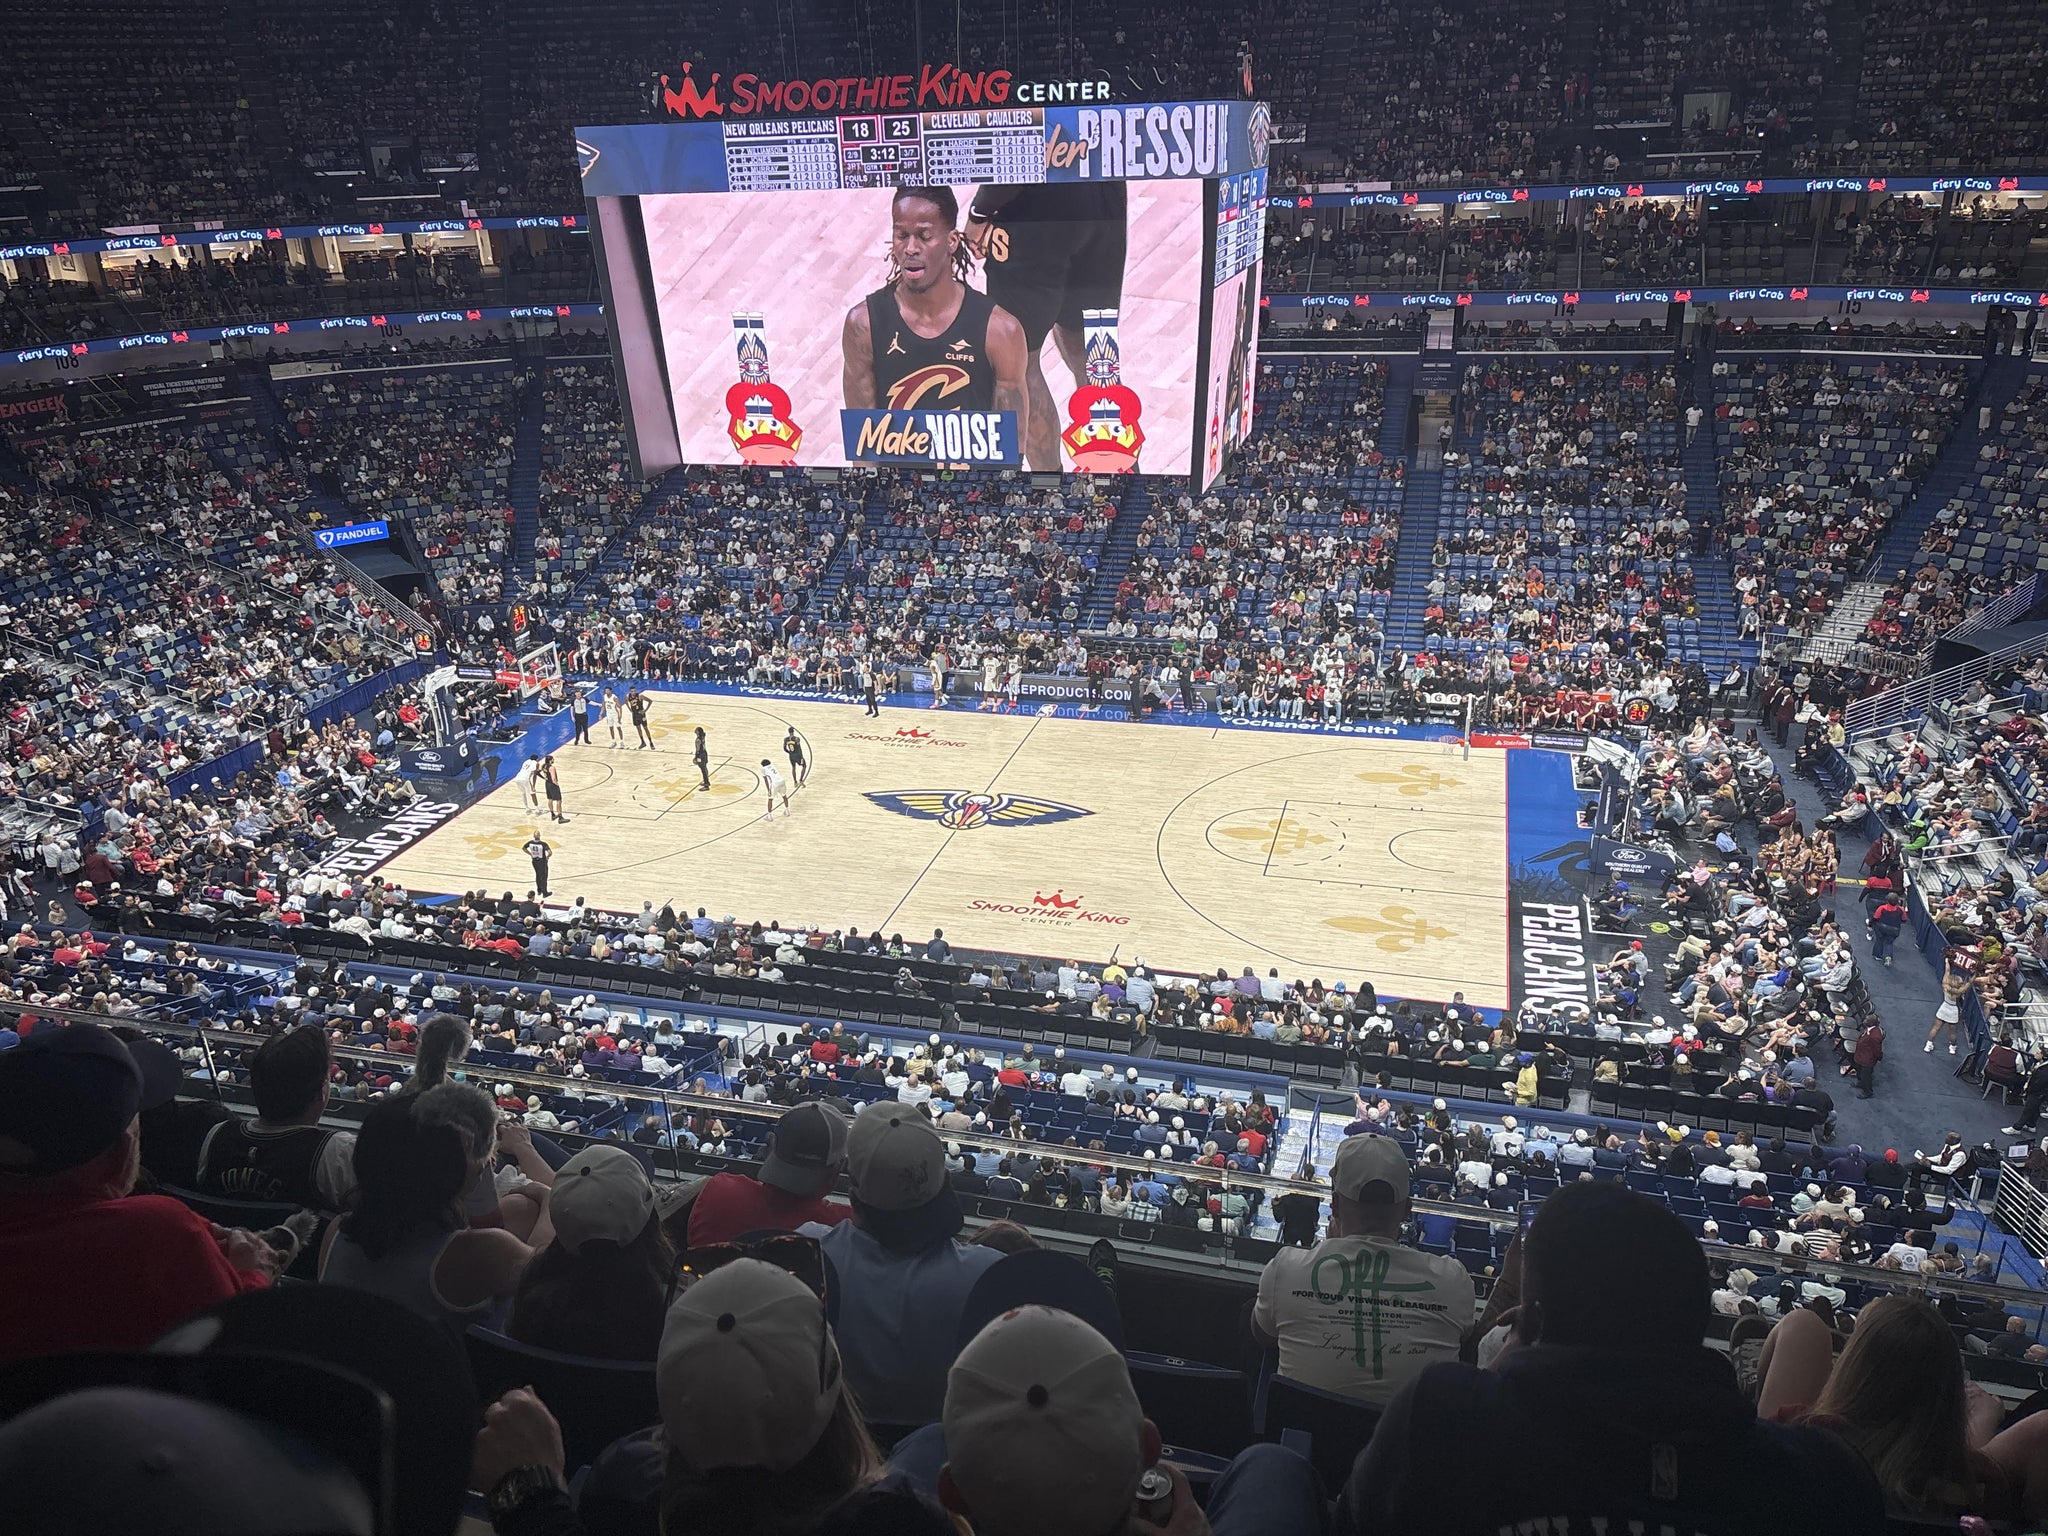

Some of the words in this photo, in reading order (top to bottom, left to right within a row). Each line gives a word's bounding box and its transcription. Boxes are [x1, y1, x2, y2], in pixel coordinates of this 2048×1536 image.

[729, 73, 913, 114] SMOOTHIE
[1017, 82, 1110, 102] CENTER
[931, 112, 981, 129] CLEVELAND
[986, 110, 1033, 127] CAVALIERS
[725, 123, 746, 136] NEW
[749, 121, 789, 135] ORLEANS
[791, 119, 835, 134] PELICANS
[852, 122, 869, 138] 18
[892, 121, 910, 136] 25
[870, 147, 895, 160] 3:12
[845, 174, 868, 182] FOULS
[1932, 178, 1961, 191] Fiery
[1964, 178, 1992, 191] Crab
[1686, 182, 1712, 194] Fiery
[1715, 182, 1740, 193] Crab
[1806, 179, 1833, 191] Fiery
[1836, 179, 1862, 191] Crab
[1458, 191, 1482, 204] Fiery
[1484, 190, 1507, 201] Crab
[1570, 186, 1594, 198] Fiery
[1598, 186, 1621, 197] Crab
[1271, 198, 1293, 208] Crab
[1350, 193, 1374, 207] Fiery
[1376, 195, 1398, 206] Crab
[419, 220, 441, 232] Fiery
[443, 219, 464, 230] Crab
[516, 217, 537, 228] Fiery
[539, 216, 559, 227] Crab
[215, 231, 239, 243] Fiery
[241, 230, 262, 240] Crab
[318, 226, 340, 236] Fiery
[342, 224, 365, 235] Crab
[106, 238, 131, 251] Fiery
[133, 236, 157, 247] Crab
[26, 245, 50, 256] Crab
[1302, 295, 1325, 306] Fiery
[1328, 295, 1350, 306] Crab
[1402, 295, 1426, 306] Fiery
[1428, 294, 1451, 305] Crab
[1507, 294, 1531, 306] Fiery
[1533, 293, 1557, 304] Crab
[1615, 291, 1641, 303] Fiery
[1644, 291, 1668, 302] Crab
[1729, 289, 1756, 301] Fiery
[1759, 288, 1784, 300] Crab
[1847, 289, 1875, 301] Fiery
[1877, 289, 1905, 302] Crab
[1971, 292, 2000, 304] Fiery
[2004, 292, 2032, 305] Crab
[417, 312, 439, 324] Fiery
[441, 311, 462, 321] Crab
[510, 306, 531, 318] Fiery
[533, 306, 553, 317] Crab
[320, 318, 342, 329] Fiery
[344, 317, 368, 327] Crab
[222, 326, 245, 338] Fiery
[247, 325, 270, 335] Crab
[119, 336, 143, 349] Fiery
[145, 334, 168, 345] Crab
[18, 350, 42, 362] Fiery
[44, 346, 68, 358] Crab
[945, 353, 975, 363] CLIFFS
[0, 394, 69, 418] EATGEEK
[856, 412, 930, 458] Make
[925, 413, 1004, 460] NOISE
[336, 526, 383, 542] FANDUEL
[747, 686, 823, 698] Ochsner
[1630, 711, 1645, 720] 24
[1231, 717, 1320, 731] Ochsner
[1323, 722, 1398, 735] Health
[843, 732, 925, 744] SMOOTHIE
[459, 743, 469, 758] G
[1617, 850, 1641, 860] Ford
[967, 900, 1073, 919] SMOOTHIE
[1021, 917, 1072, 927] CENTER
[1522, 902, 1590, 1018] PELICANS
[1317, 1292, 1344, 1302] YOUR
[1348, 1295, 1390, 1307] VIEWING
[1311, 1249, 1436, 1380] Off
[1389, 1343, 1402, 1355] the
